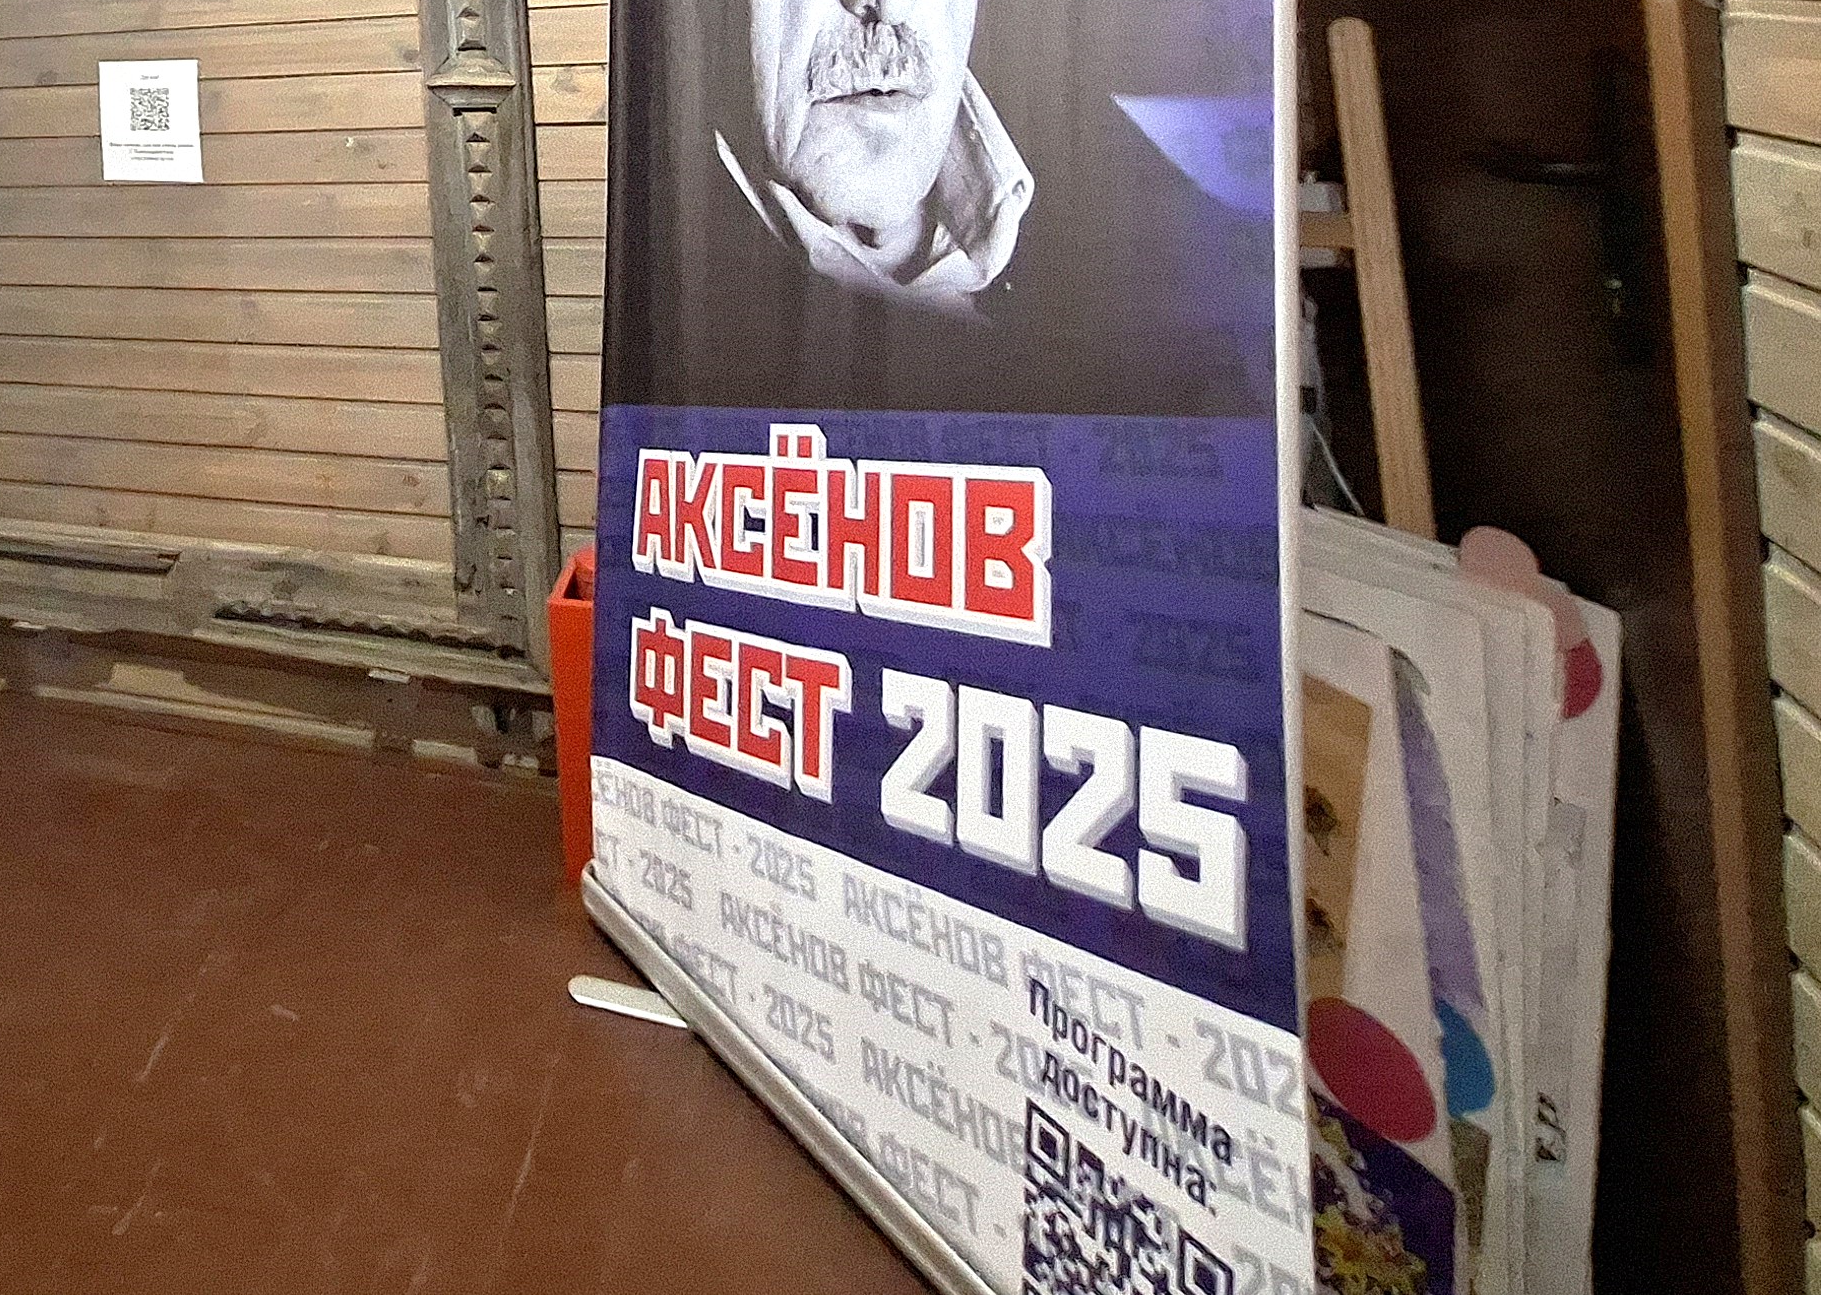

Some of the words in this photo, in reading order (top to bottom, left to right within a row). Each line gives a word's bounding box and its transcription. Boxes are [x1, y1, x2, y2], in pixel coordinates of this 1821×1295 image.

[634, 422, 1052, 648] АКСЁНОВ
[629, 606, 852, 804] ФЕСТ
[879, 666, 1249, 953] 2025
[661, 796, 724, 859] ФЕСТ
[746, 832, 819, 903] 2025
[762, 982, 837, 1066] 2025
[857, 958, 957, 1051] ФЕСТ
[1029, 972, 1235, 1169] Программа
